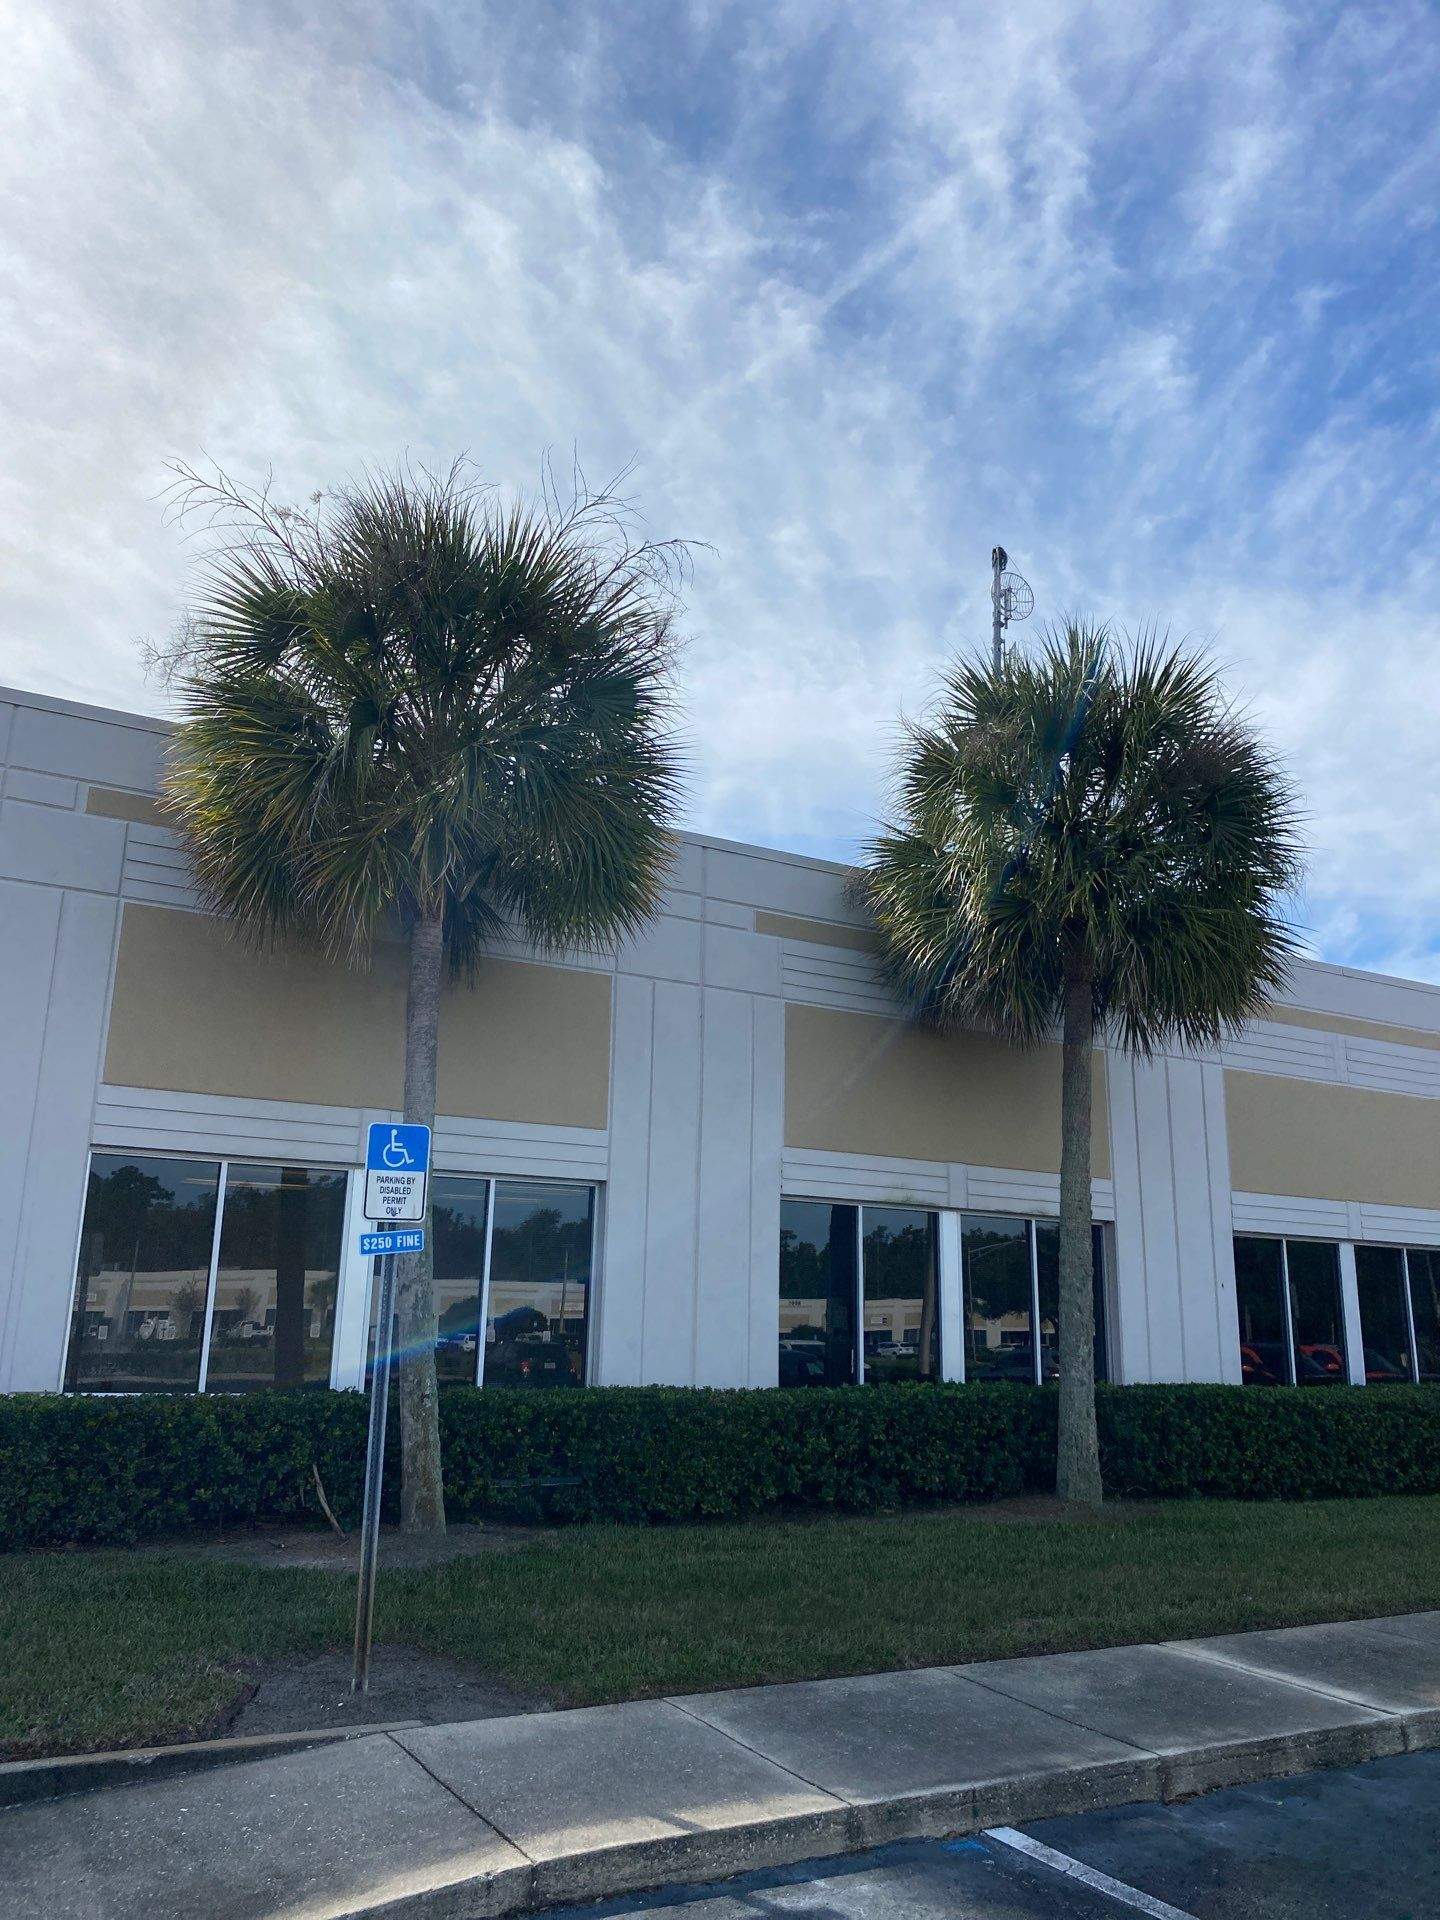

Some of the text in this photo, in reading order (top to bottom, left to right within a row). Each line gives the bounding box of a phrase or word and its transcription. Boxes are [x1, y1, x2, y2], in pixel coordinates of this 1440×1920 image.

[376, 1175, 416, 1185] PARKING BY
[380, 1186, 411, 1195] DISABLED
[382, 1196, 407, 1205] PERMIT
[363, 1234, 420, 1251] $250 FINE
